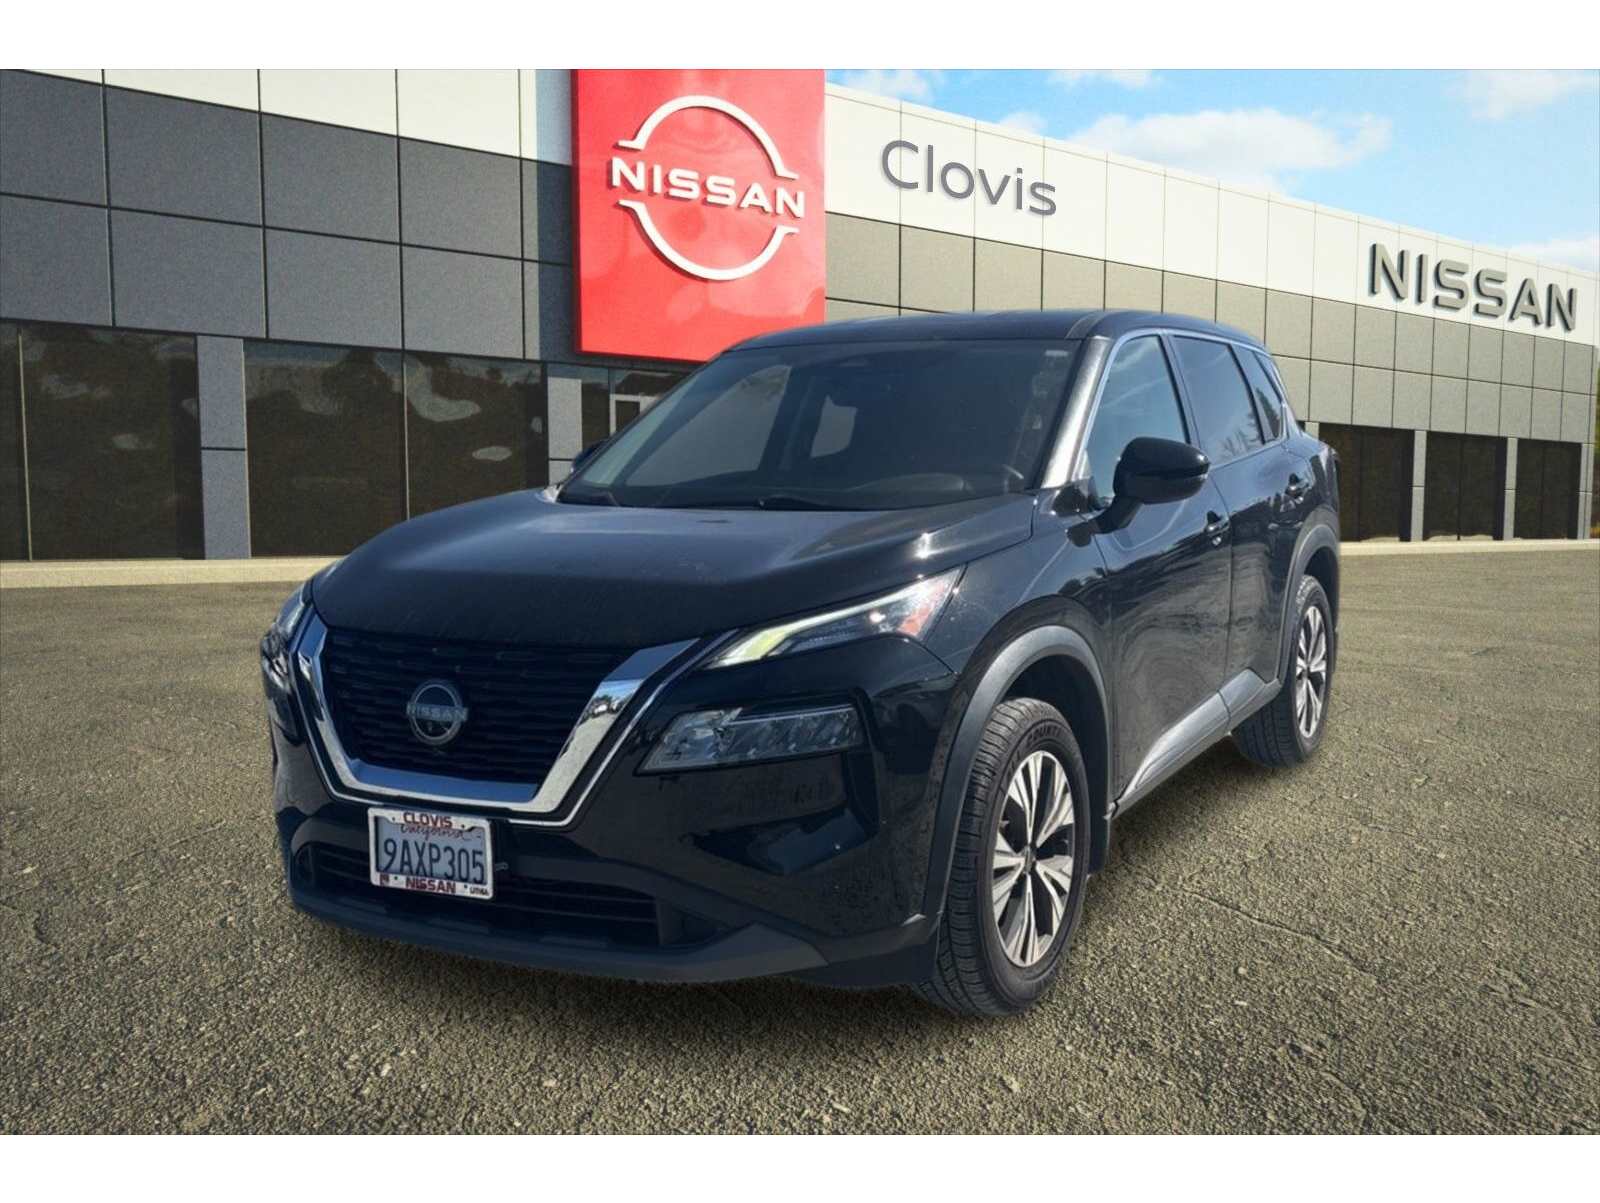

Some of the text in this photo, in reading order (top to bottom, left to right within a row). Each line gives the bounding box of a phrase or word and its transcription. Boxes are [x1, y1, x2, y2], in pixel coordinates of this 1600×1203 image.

[611, 156, 805, 219] NISSAN
[881, 140, 1057, 216] Clovis
[1369, 243, 1578, 331] NISSAN
[403, 811, 453, 828] CLOVIS
[384, 838, 484, 884] 9AXP305
[406, 877, 457, 894] NISSAN
